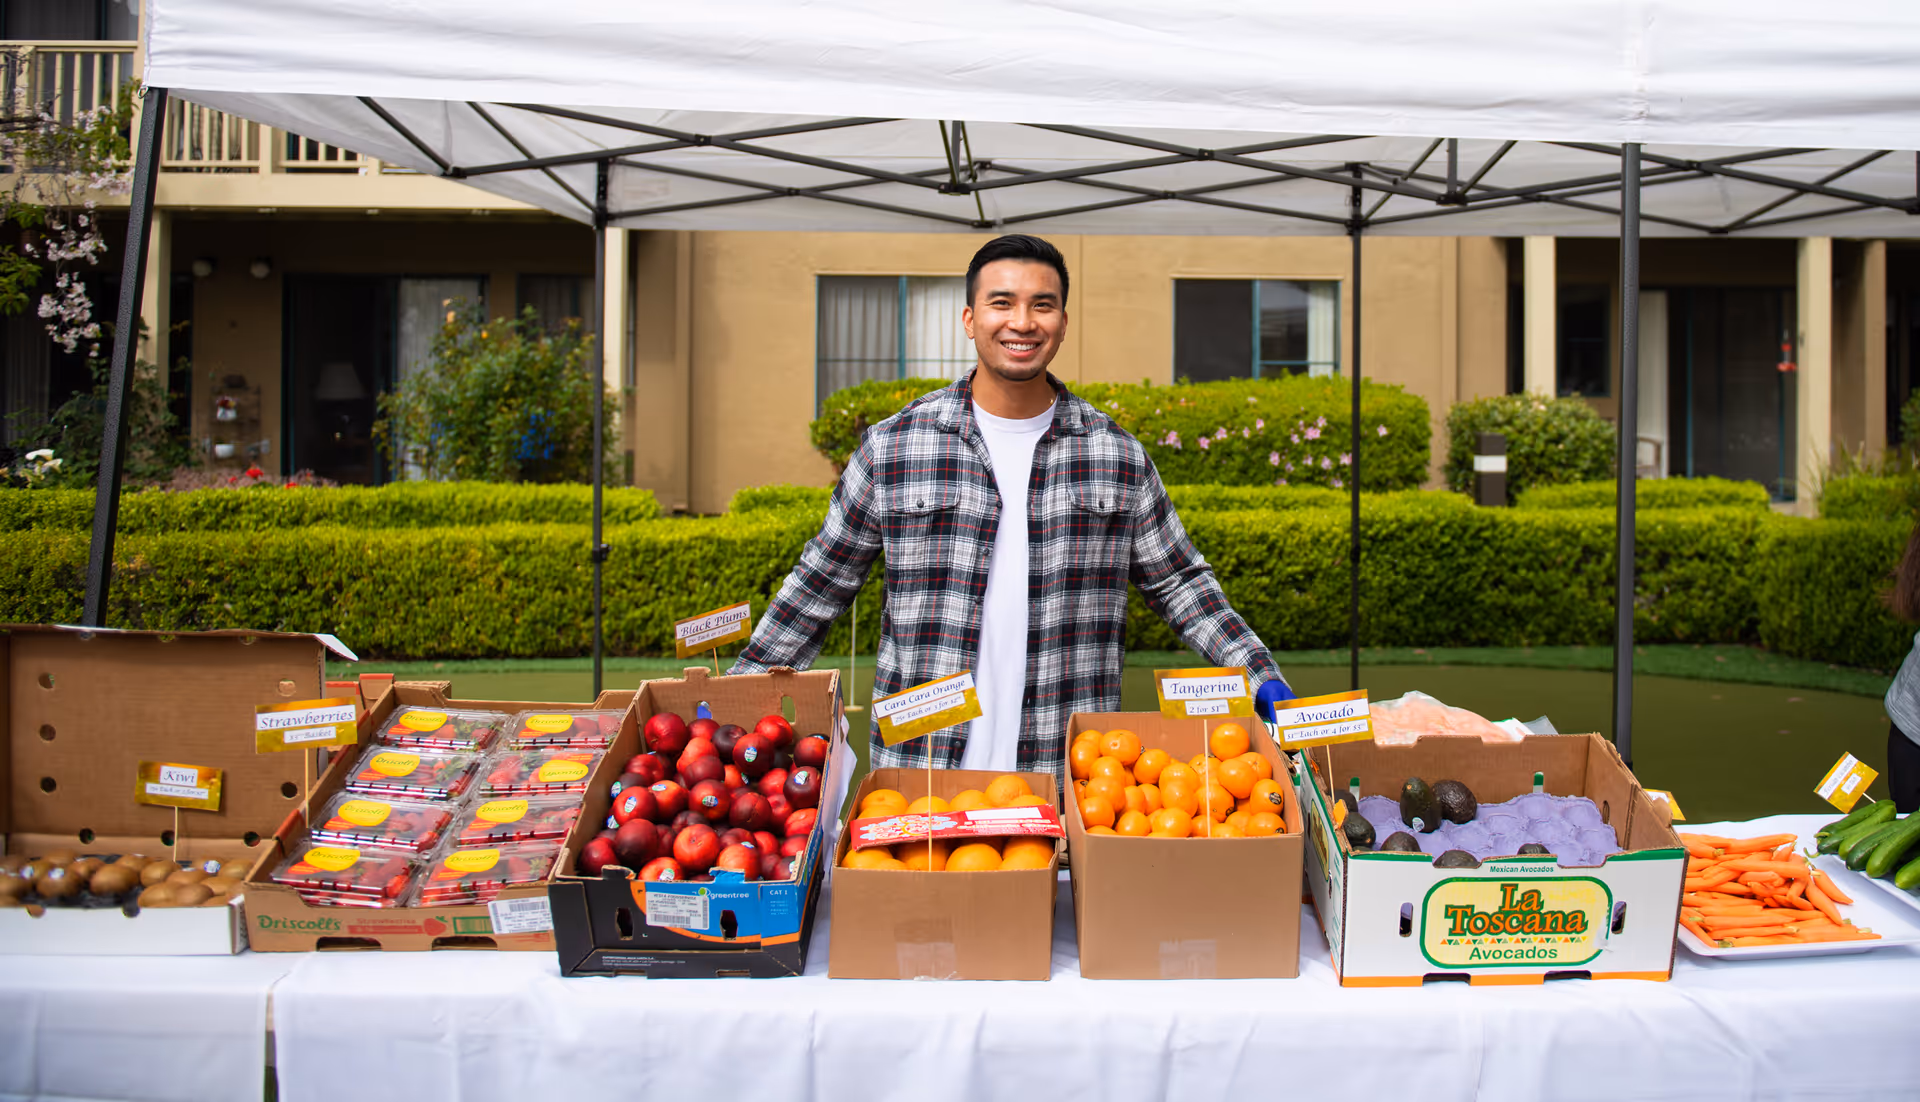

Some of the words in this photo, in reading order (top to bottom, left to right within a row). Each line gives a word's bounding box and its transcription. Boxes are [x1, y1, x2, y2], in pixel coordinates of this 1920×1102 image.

[680, 617, 711, 637] Black
[715, 610, 748, 627] Plums
[884, 699, 906, 711] Cara
[908, 690, 931, 704] Cara
[932, 679, 966, 696] Orange
[1170, 681, 1239, 698] Tangerine
[907, 708, 923, 718] Each
[938, 700, 949, 710] for
[1189, 706, 1195, 714] 2
[1196, 705, 1209, 714] for
[1294, 703, 1354, 724] Avocado
[260, 710, 354, 729] Strawberries
[1300, 728, 1319, 738] Each
[1339, 724, 1351, 733] for
[163, 768, 196, 783] Kiwi
[1489, 865, 1519, 873] Mexican
[1519, 865, 1554, 873] Avocados
[710, 892, 750, 900] greentree
[1498, 883, 1545, 912] La
[256, 914, 342, 931] Driscoll's
[1444, 904, 1589, 937] Toscana
[1468, 946, 1558, 961] Avocados
